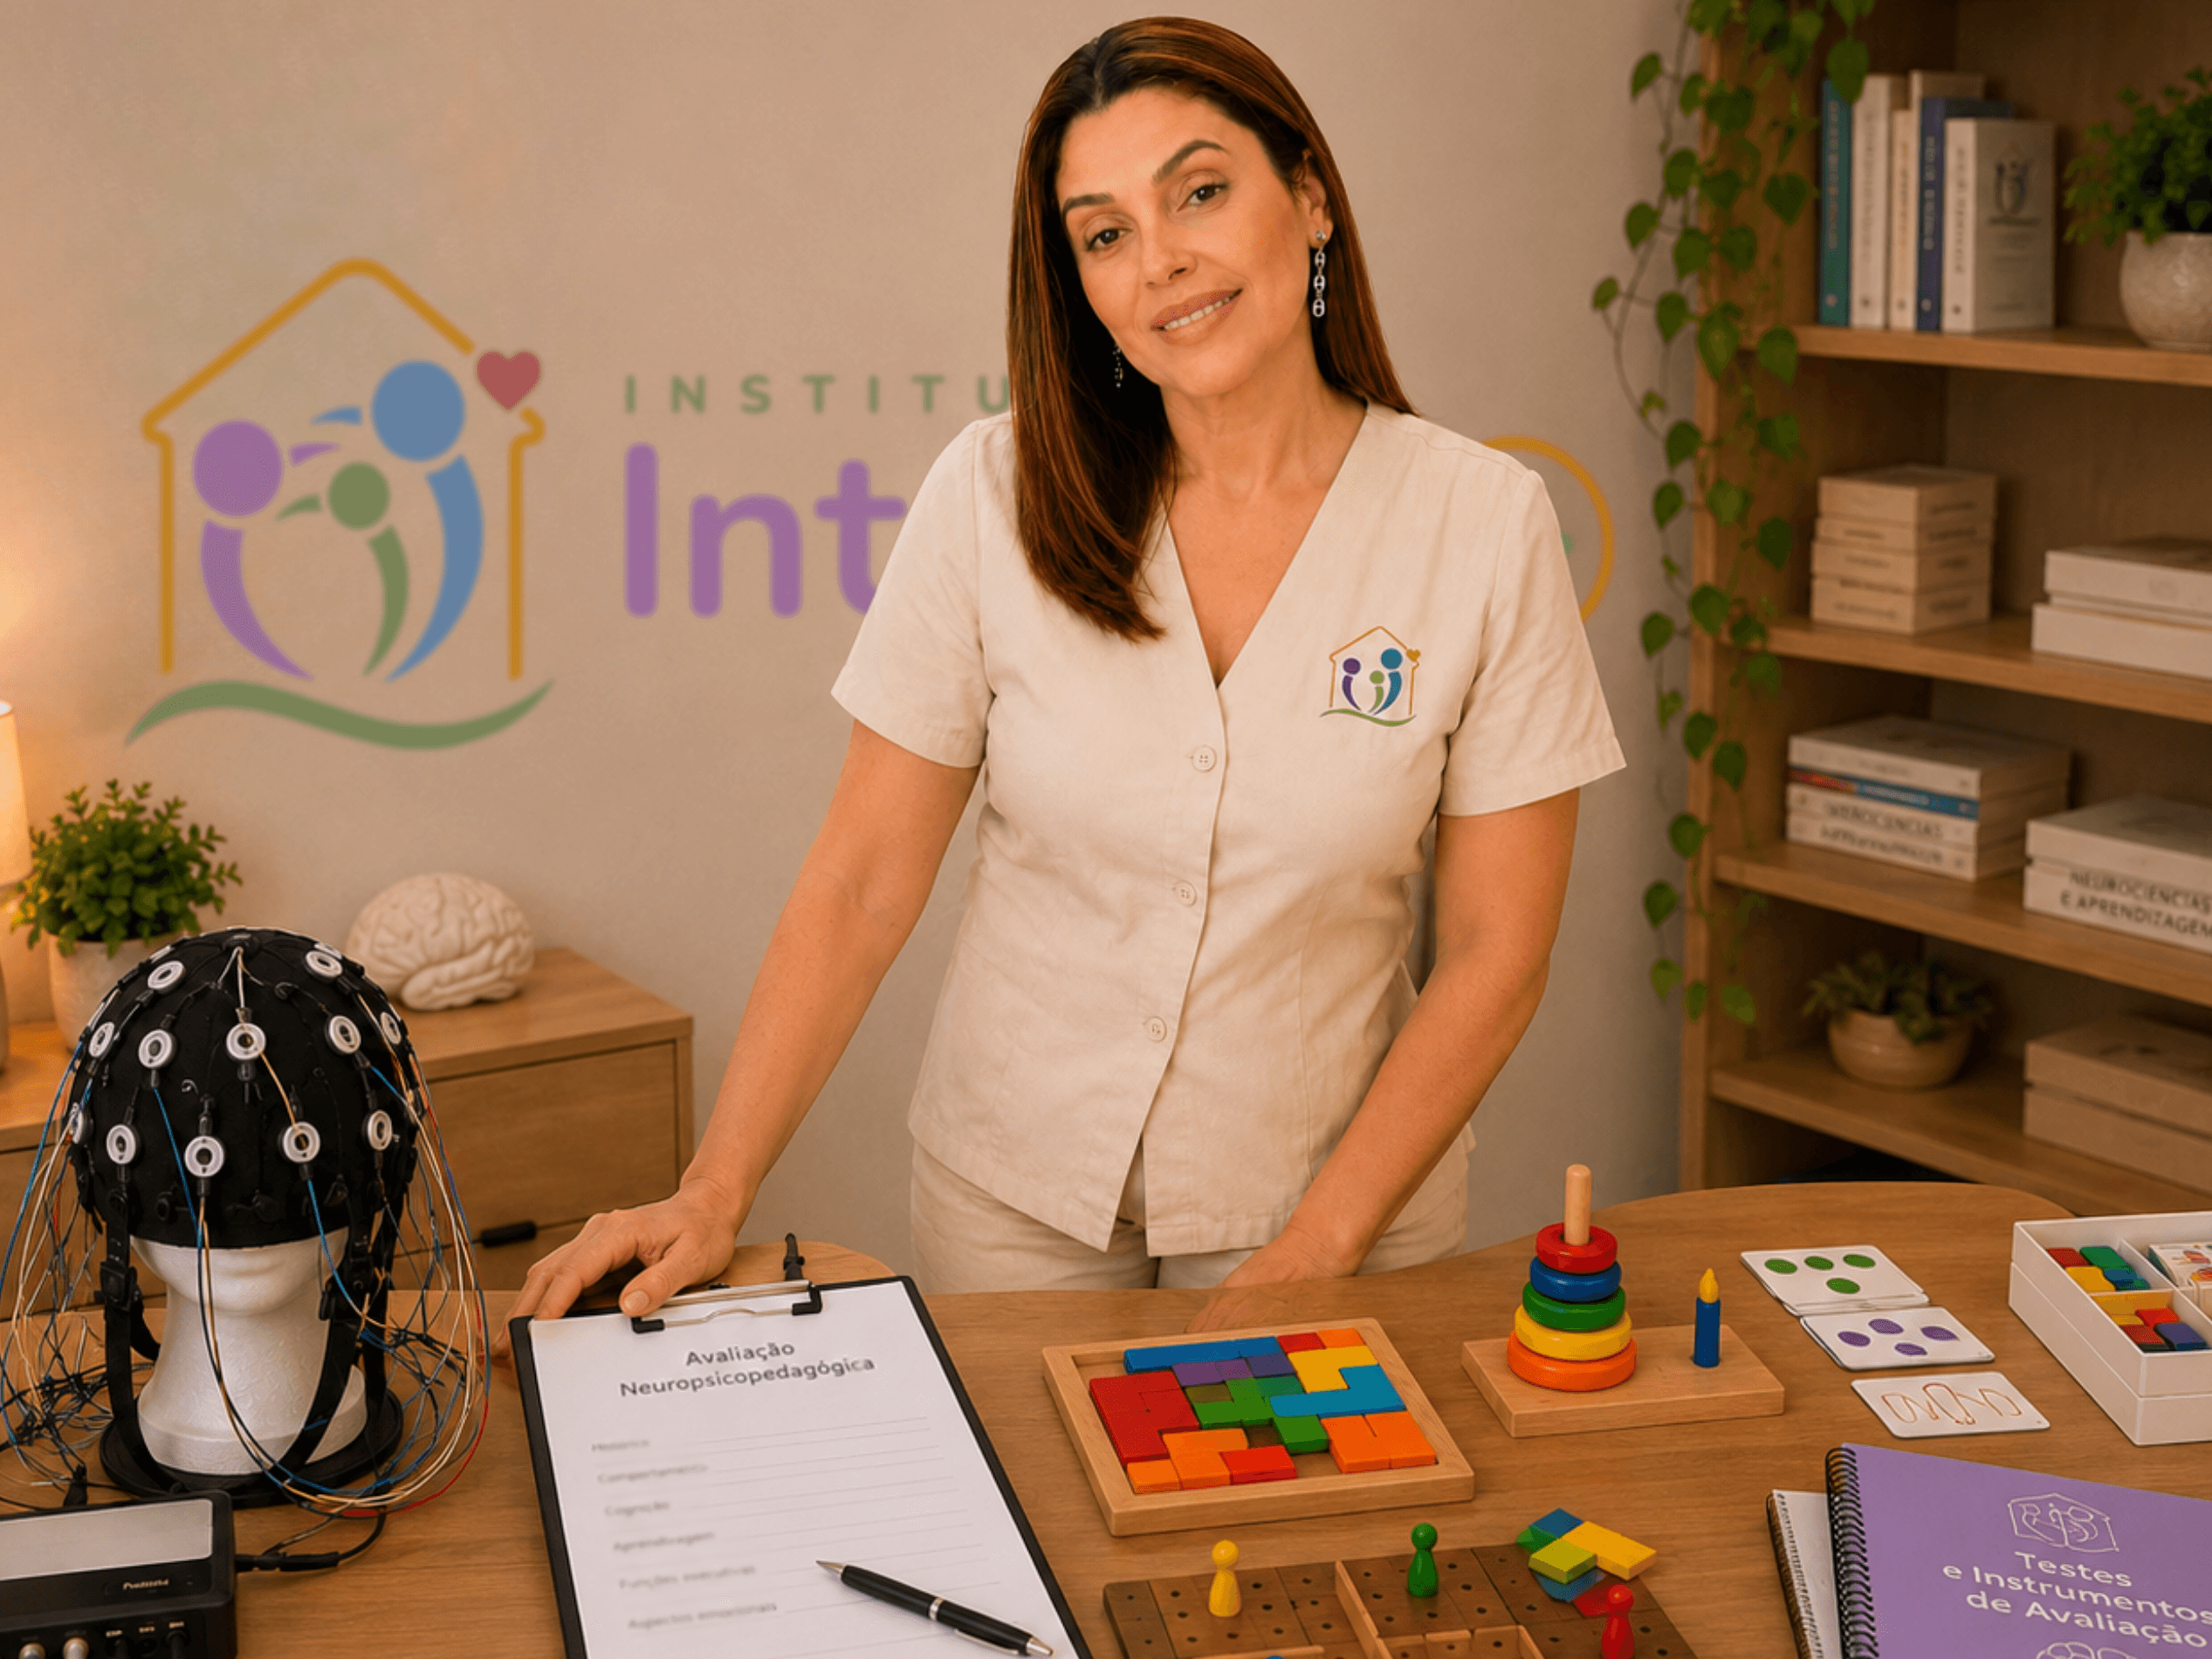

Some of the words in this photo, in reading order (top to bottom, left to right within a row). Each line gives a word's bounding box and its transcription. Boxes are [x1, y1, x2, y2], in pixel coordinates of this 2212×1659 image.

[685, 1342, 795, 1367] Avaliação
[620, 1357, 875, 1397] Neuropsicopedagógica
[2015, 1551, 2132, 1587] Testes
[1942, 1565, 1962, 1580] e
[1973, 1566, 2212, 1625] Instrumentos
[1966, 1590, 2011, 1614] de
[2025, 1601, 2208, 1648] Avaliação
